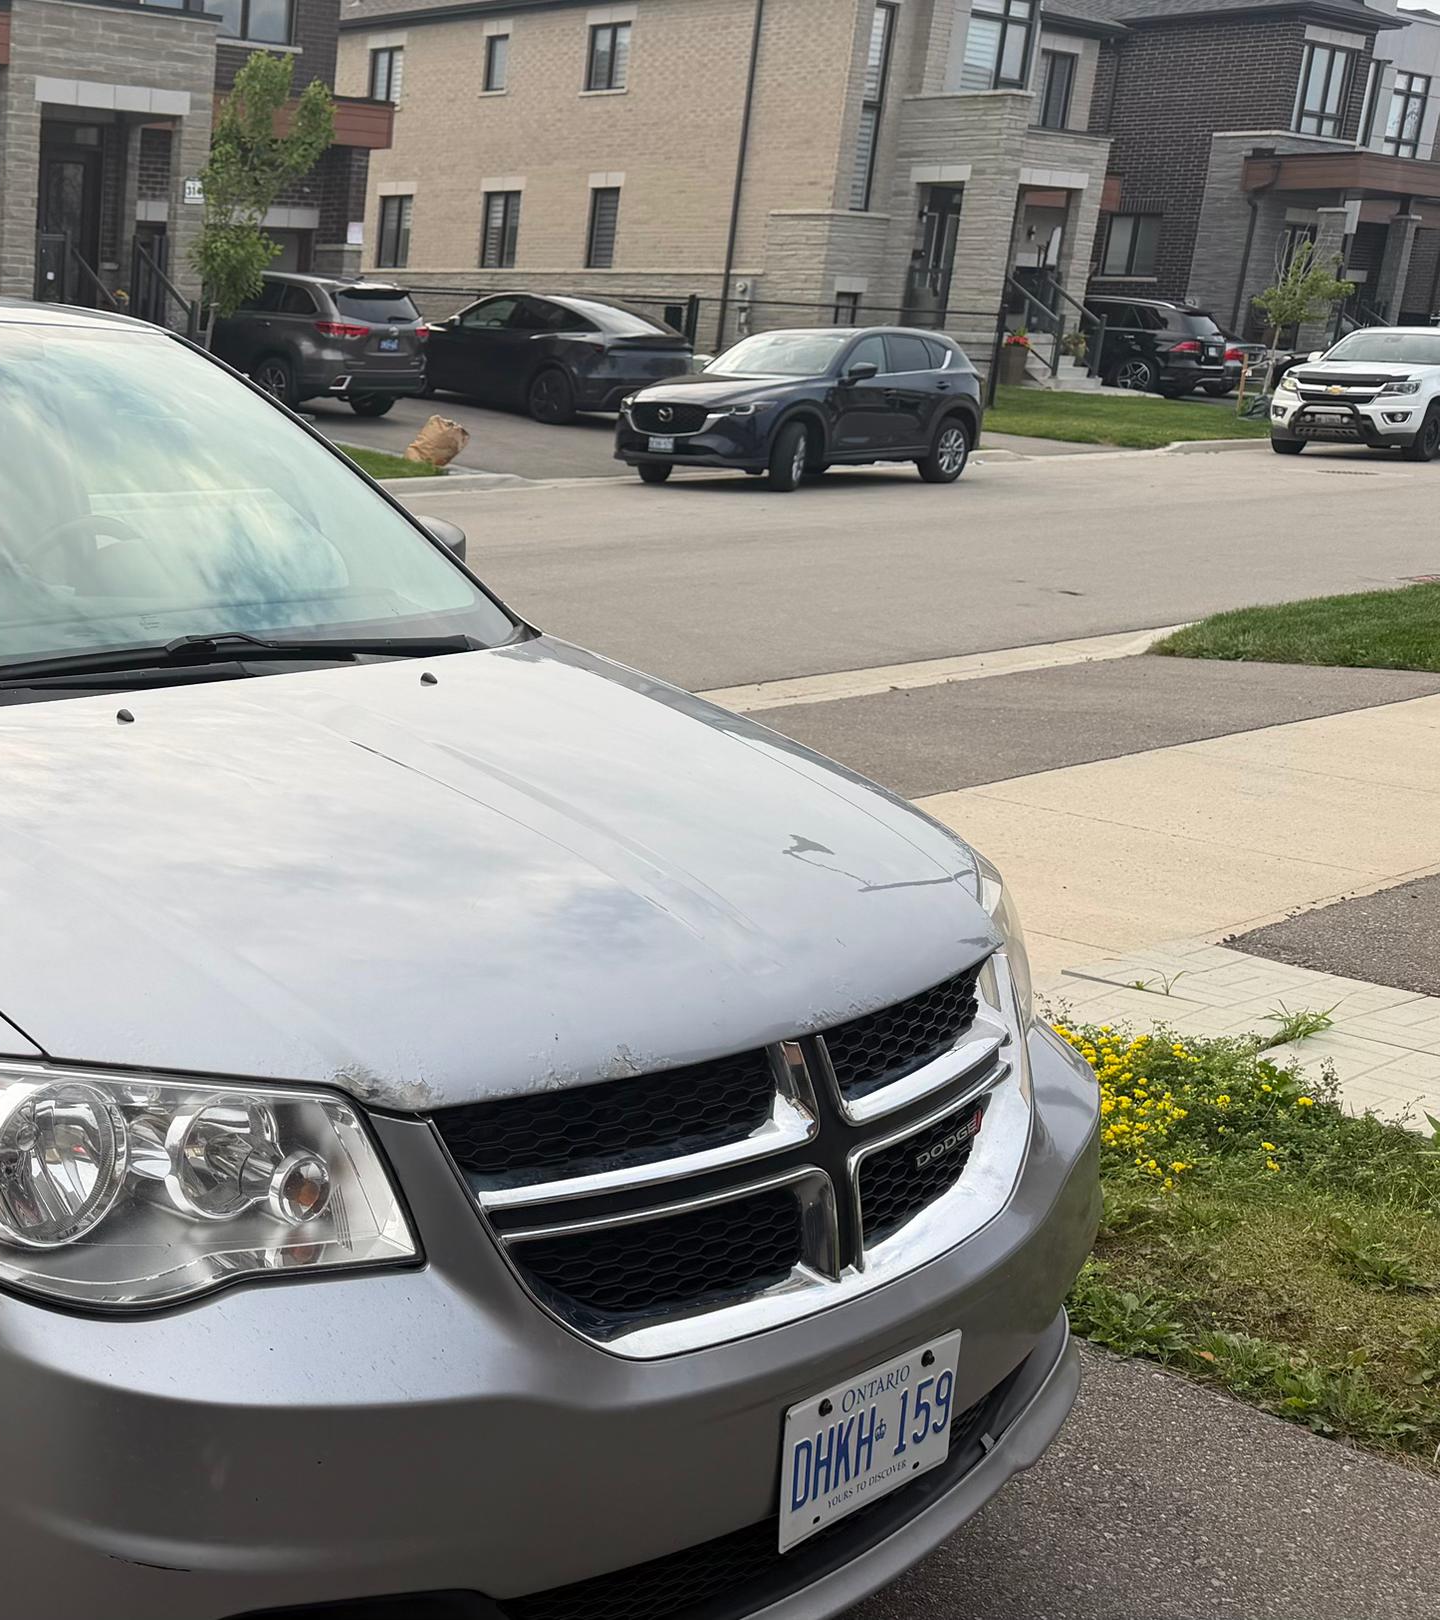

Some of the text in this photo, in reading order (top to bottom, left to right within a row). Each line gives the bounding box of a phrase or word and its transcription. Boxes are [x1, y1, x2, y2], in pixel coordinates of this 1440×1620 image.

[915, 1118, 978, 1168] DODGE
[842, 1364, 911, 1414] ONTARIO
[791, 1368, 953, 1512] DHKH 159
[827, 1459, 907, 1509] YOURS TO DISCOVER
